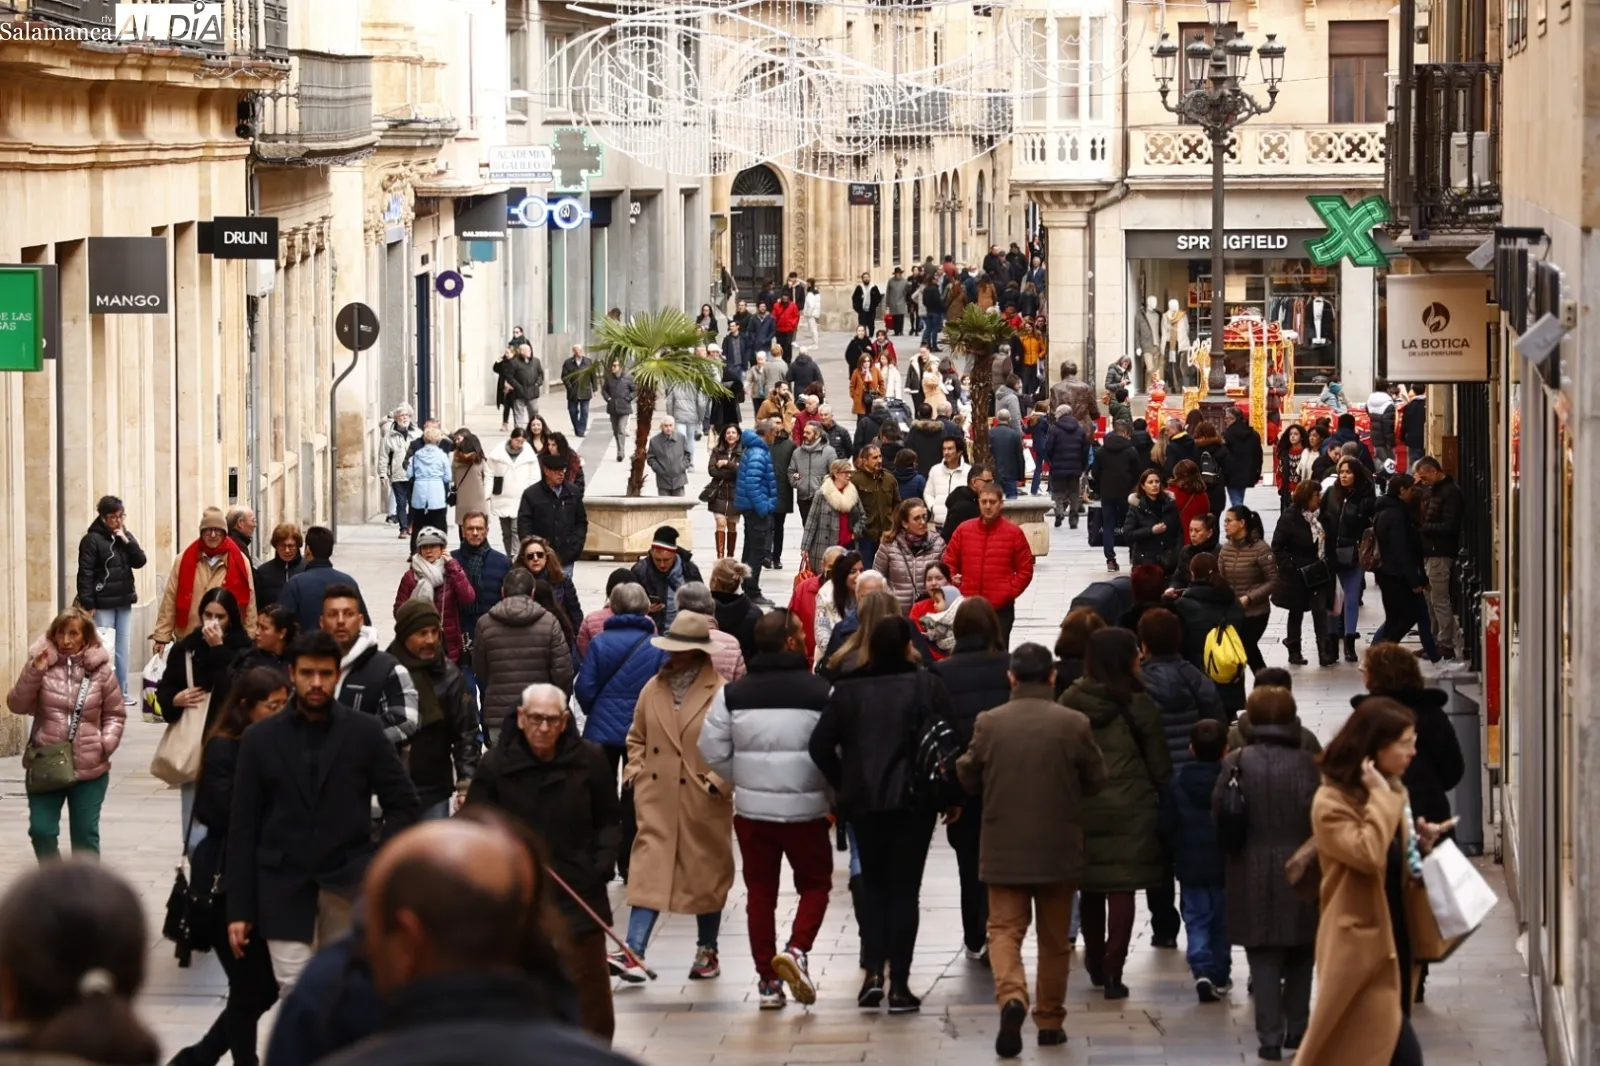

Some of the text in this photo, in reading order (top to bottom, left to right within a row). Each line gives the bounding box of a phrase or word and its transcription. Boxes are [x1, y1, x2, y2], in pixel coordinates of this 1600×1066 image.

[497, 150, 546, 159] ACADEMIA
[502, 160, 541, 170] GALILEO
[223, 231, 268, 245] DRUNI
[1176, 235, 1288, 249] SPRGFIELD
[96, 295, 160, 307] MANGO
[12, 312, 33, 322] LAS
[1401, 338, 1470, 349] LA BOTICA
